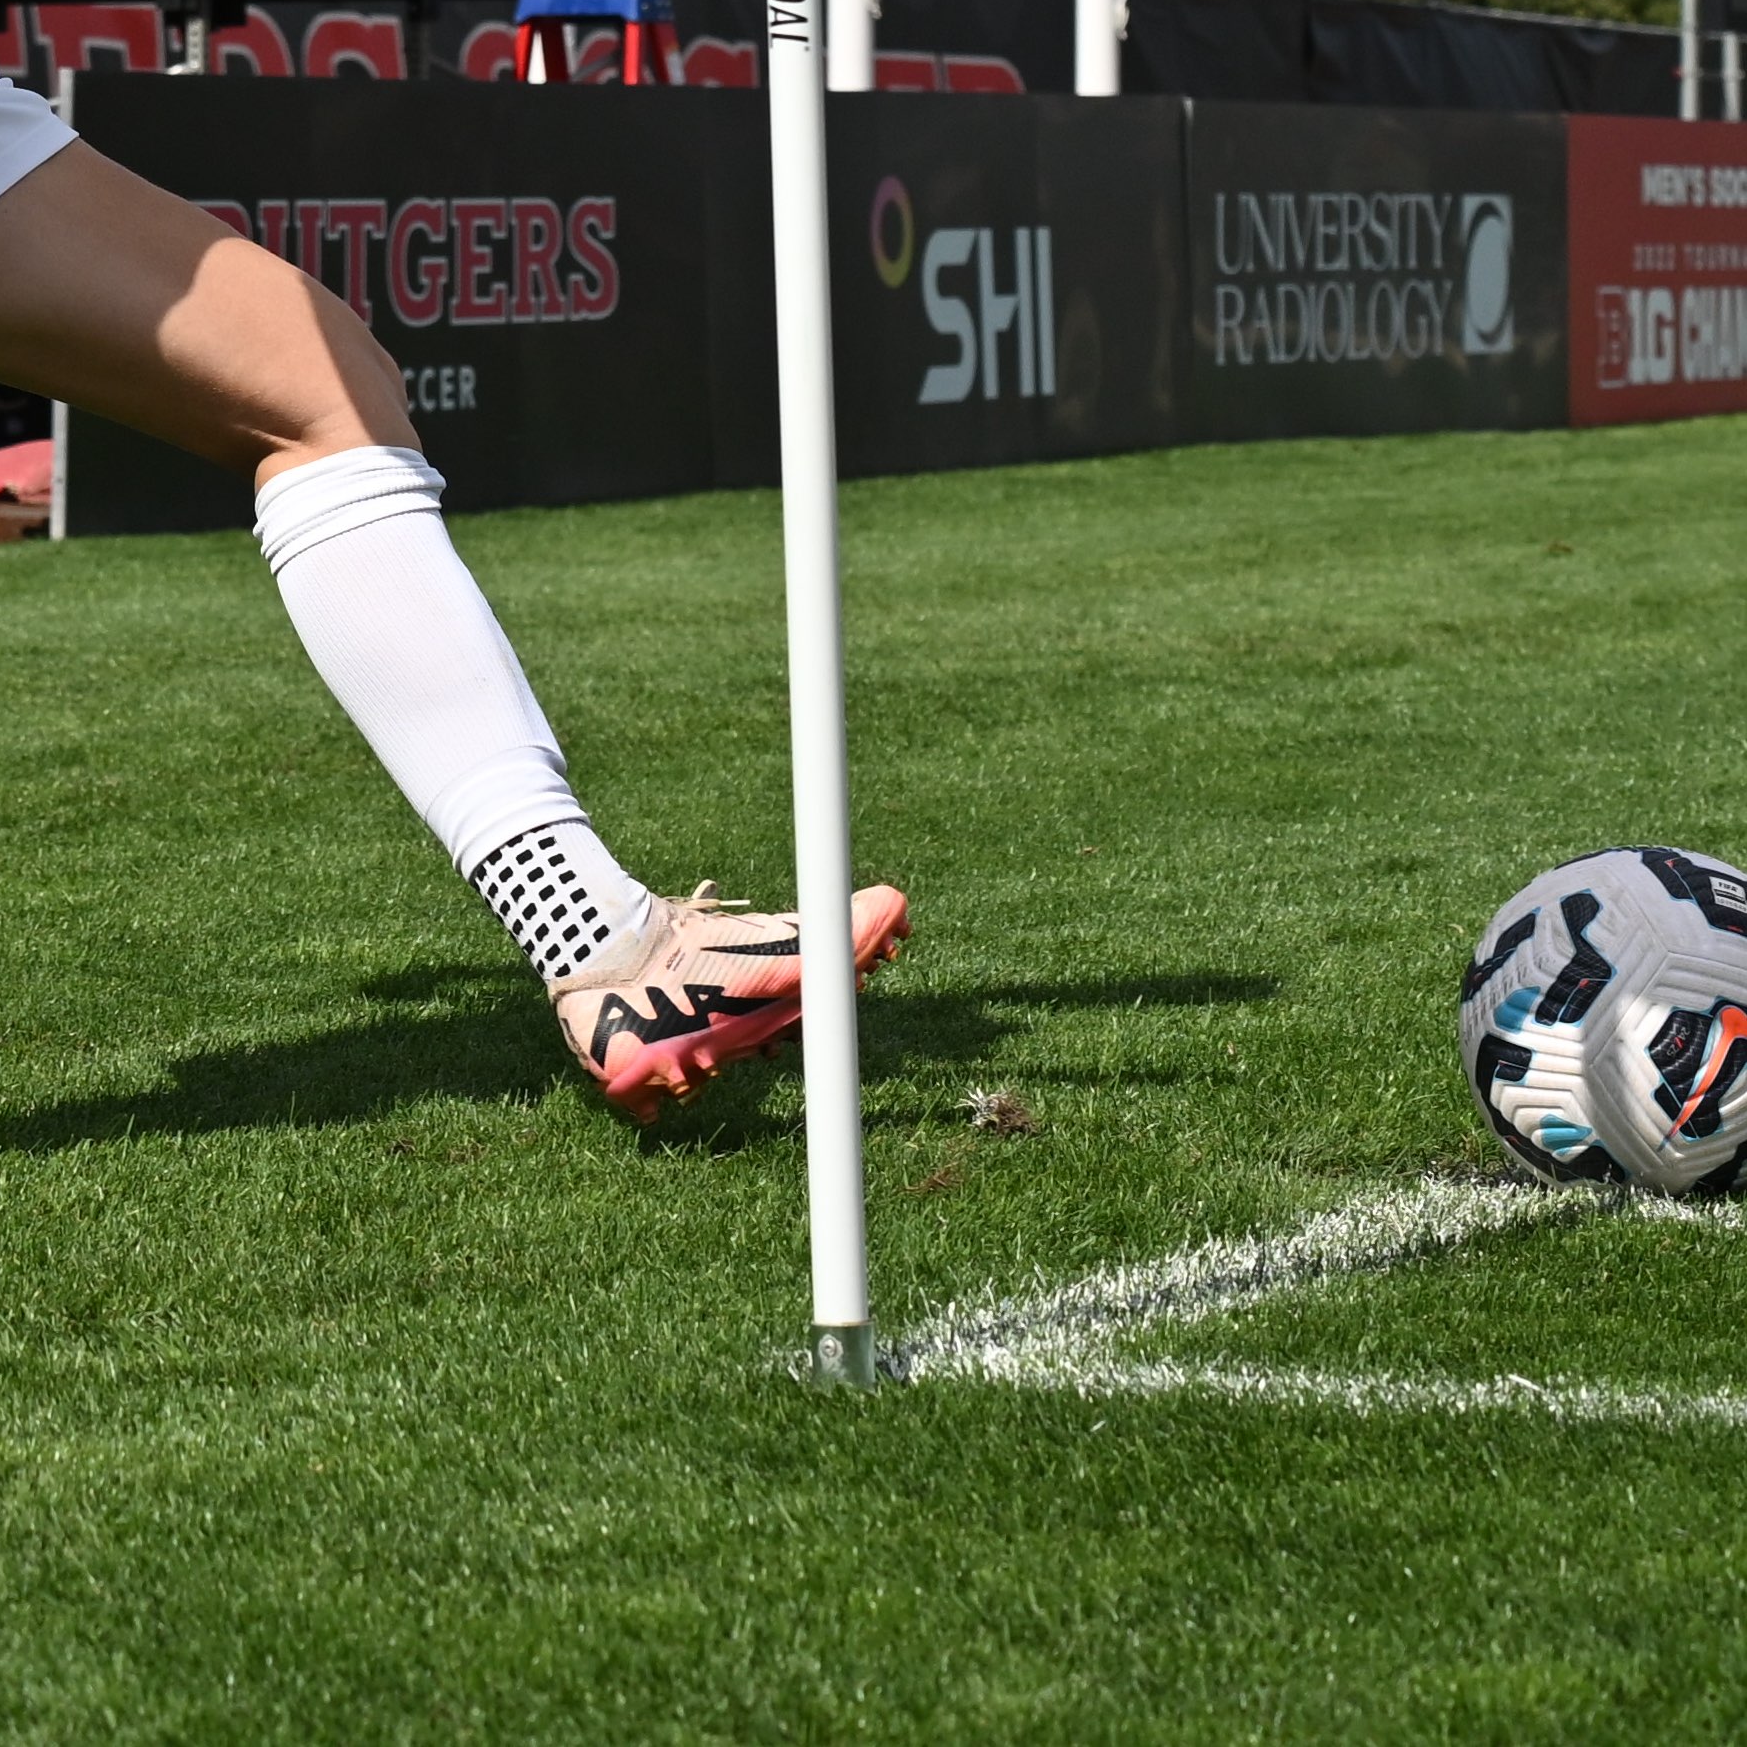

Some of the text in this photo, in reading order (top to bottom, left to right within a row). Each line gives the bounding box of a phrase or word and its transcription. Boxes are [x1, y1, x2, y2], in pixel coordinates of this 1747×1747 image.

[1215, 192, 1453, 275] UNIVERSITY
[918, 226, 1056, 404] SHI
[1215, 280, 1453, 365] RADIOLOGY
